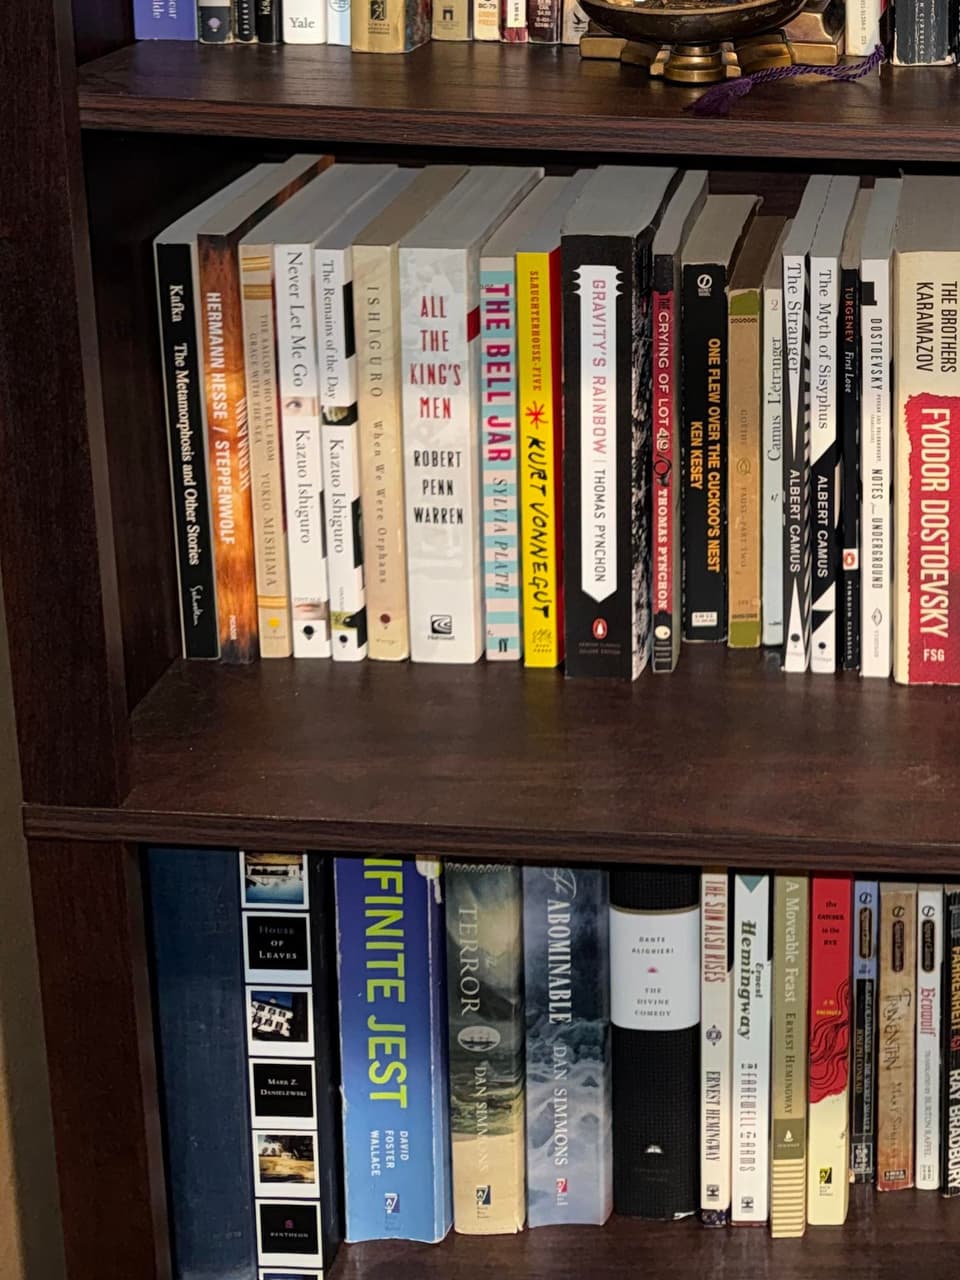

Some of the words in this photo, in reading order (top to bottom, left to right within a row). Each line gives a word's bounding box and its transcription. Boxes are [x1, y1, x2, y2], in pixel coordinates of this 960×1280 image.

[289, 17, 315, 29] Yale
[287, 251, 304, 299] Never
[941, 281, 958, 305] THE
[169, 285, 184, 322] Kafka
[289, 305, 305, 330] Let
[420, 296, 447, 318] ALL
[485, 284, 510, 331] THE
[592, 279, 607, 367] GRAVITY'S
[818, 303, 832, 341] Myth
[916, 282, 934, 372] KARAMAZOV
[206, 292, 225, 368] HERMANN
[291, 336, 308, 359] Me
[367, 286, 383, 397] ISHIGURO
[420, 330, 449, 352] THE
[529, 271, 542, 391] SLAUGHTERHOUSE-FIVE
[657, 311, 669, 368] CRYING
[708, 338, 721, 363] ONE
[787, 295, 801, 375] Stranger
[941, 310, 958, 373] BROTHERS
[293, 363, 308, 388] Go
[410, 363, 461, 386] KING'S
[485, 344, 511, 403] BELL
[870, 318, 883, 391] DOSTOEVSKY
[210, 373, 228, 420] HESSE
[657, 373, 669, 394] OF
[708, 366, 721, 403] FLEW
[817, 365, 832, 430] Sisyphus
[420, 398, 452, 419] MEN
[592, 376, 607, 454] RAINBOW
[657, 398, 669, 426] LOT
[708, 406, 721, 442] OVER
[413, 451, 462, 468] ROBERT
[487, 415, 512, 461] JAR
[921, 408, 950, 492] FYODOR
[422, 480, 454, 496] PENN
[526, 436, 548, 497] KURT
[215, 441, 235, 545] STEPPENWOLF
[295, 484, 313, 544] Ishiguro
[413, 507, 464, 524] WARREN
[789, 469, 800, 520] ALBERT
[527, 502, 553, 619] VONNEGUT
[789, 525, 800, 573] CAMUS
[920, 499, 949, 638] DOSTOEVSKY
[923, 649, 945, 662] FSG
[363, 858, 406, 1003] FINITE
[547, 899, 572, 1025] ABOMINABLE
[737, 920, 757, 1040] Hemingway
[367, 1014, 408, 1109] JEST
[553, 1046, 568, 1081] DAN
[705, 1071, 721, 1106] ERNEST
[399, 1131, 409, 1161] DAVID
[553, 1088, 569, 1166] SIMMONS
[705, 1109, 720, 1162] HEMINGWAY
